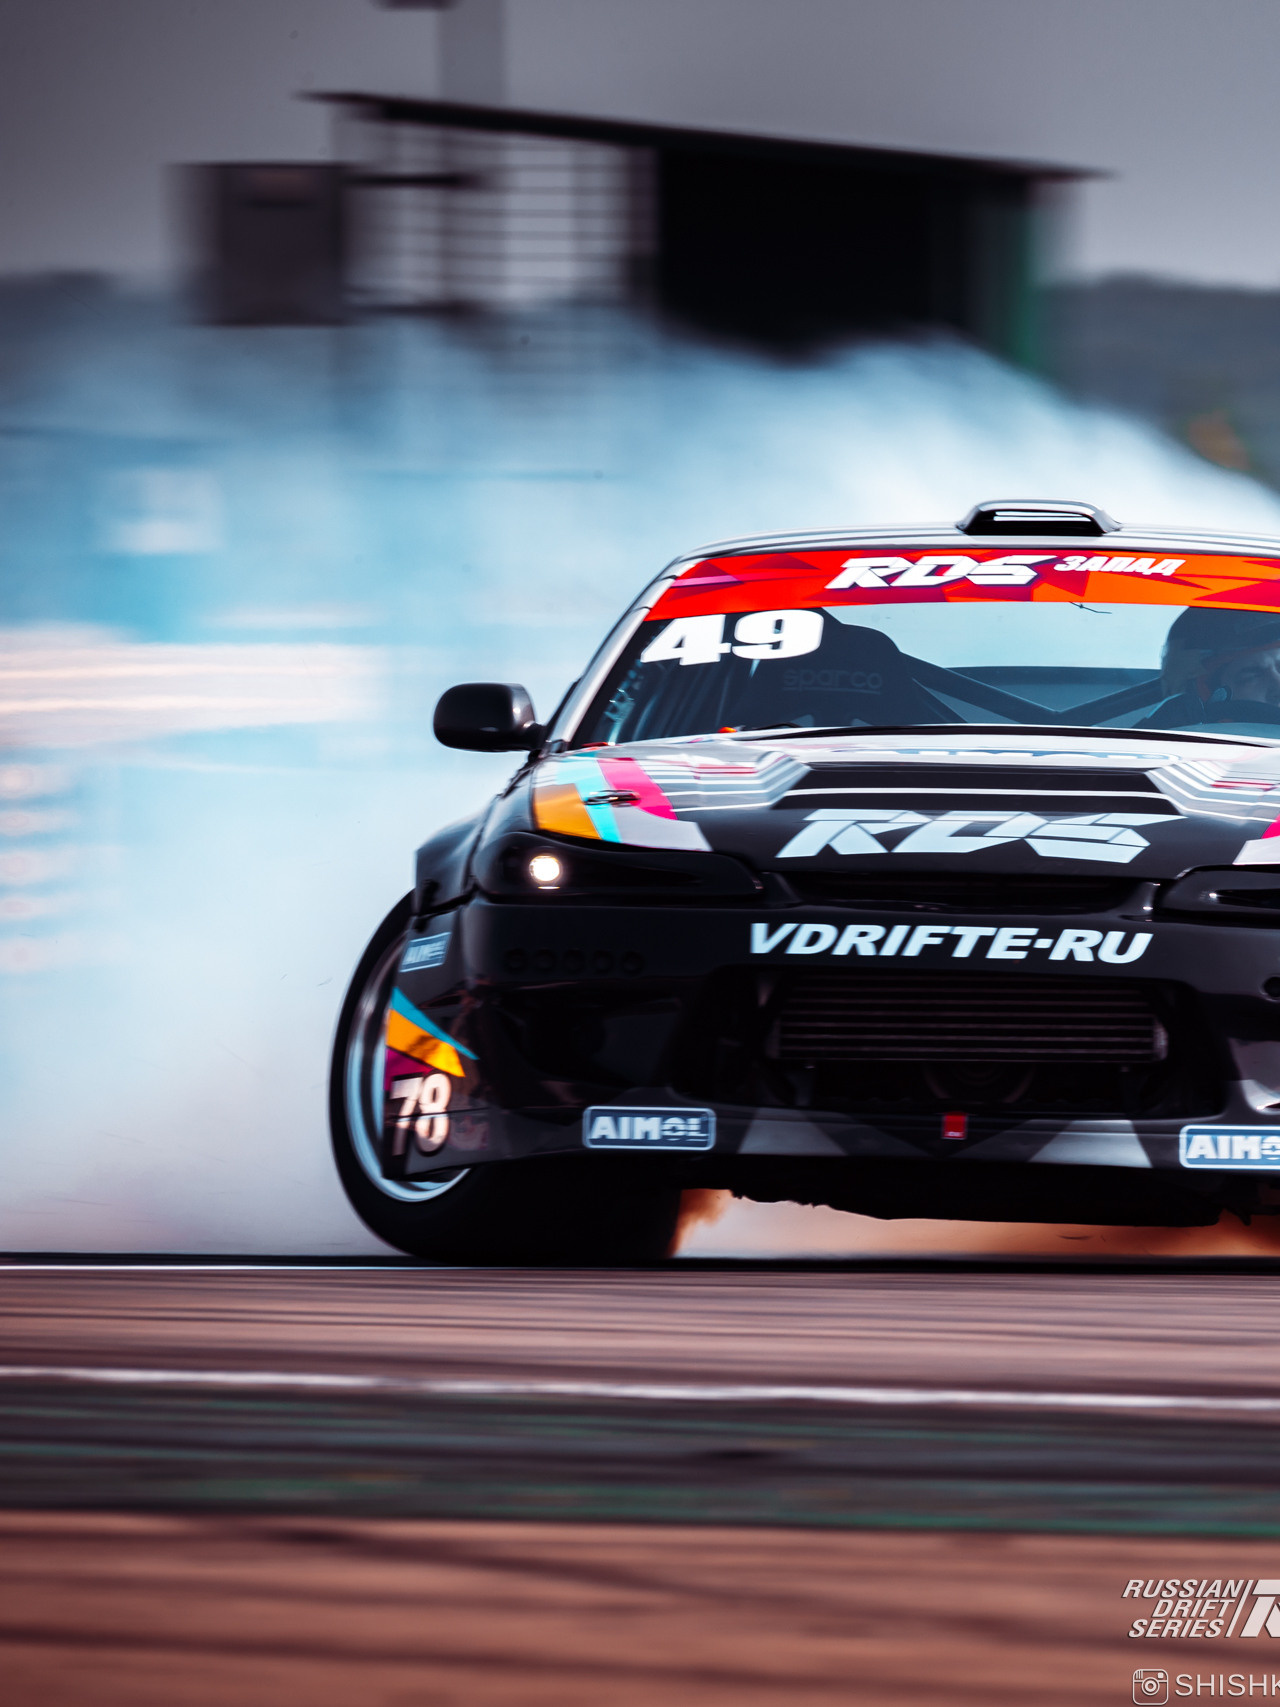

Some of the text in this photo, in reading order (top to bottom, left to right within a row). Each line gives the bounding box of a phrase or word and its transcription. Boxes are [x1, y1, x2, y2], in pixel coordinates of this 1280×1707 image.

[825, 554, 1059, 590] RDS
[1053, 555, 1187, 577] ЗАПАД
[640, 608, 825, 667] 49
[783, 668, 883, 693] sparco
[775, 808, 1189, 864] RDS
[390, 1072, 452, 1157] 78
